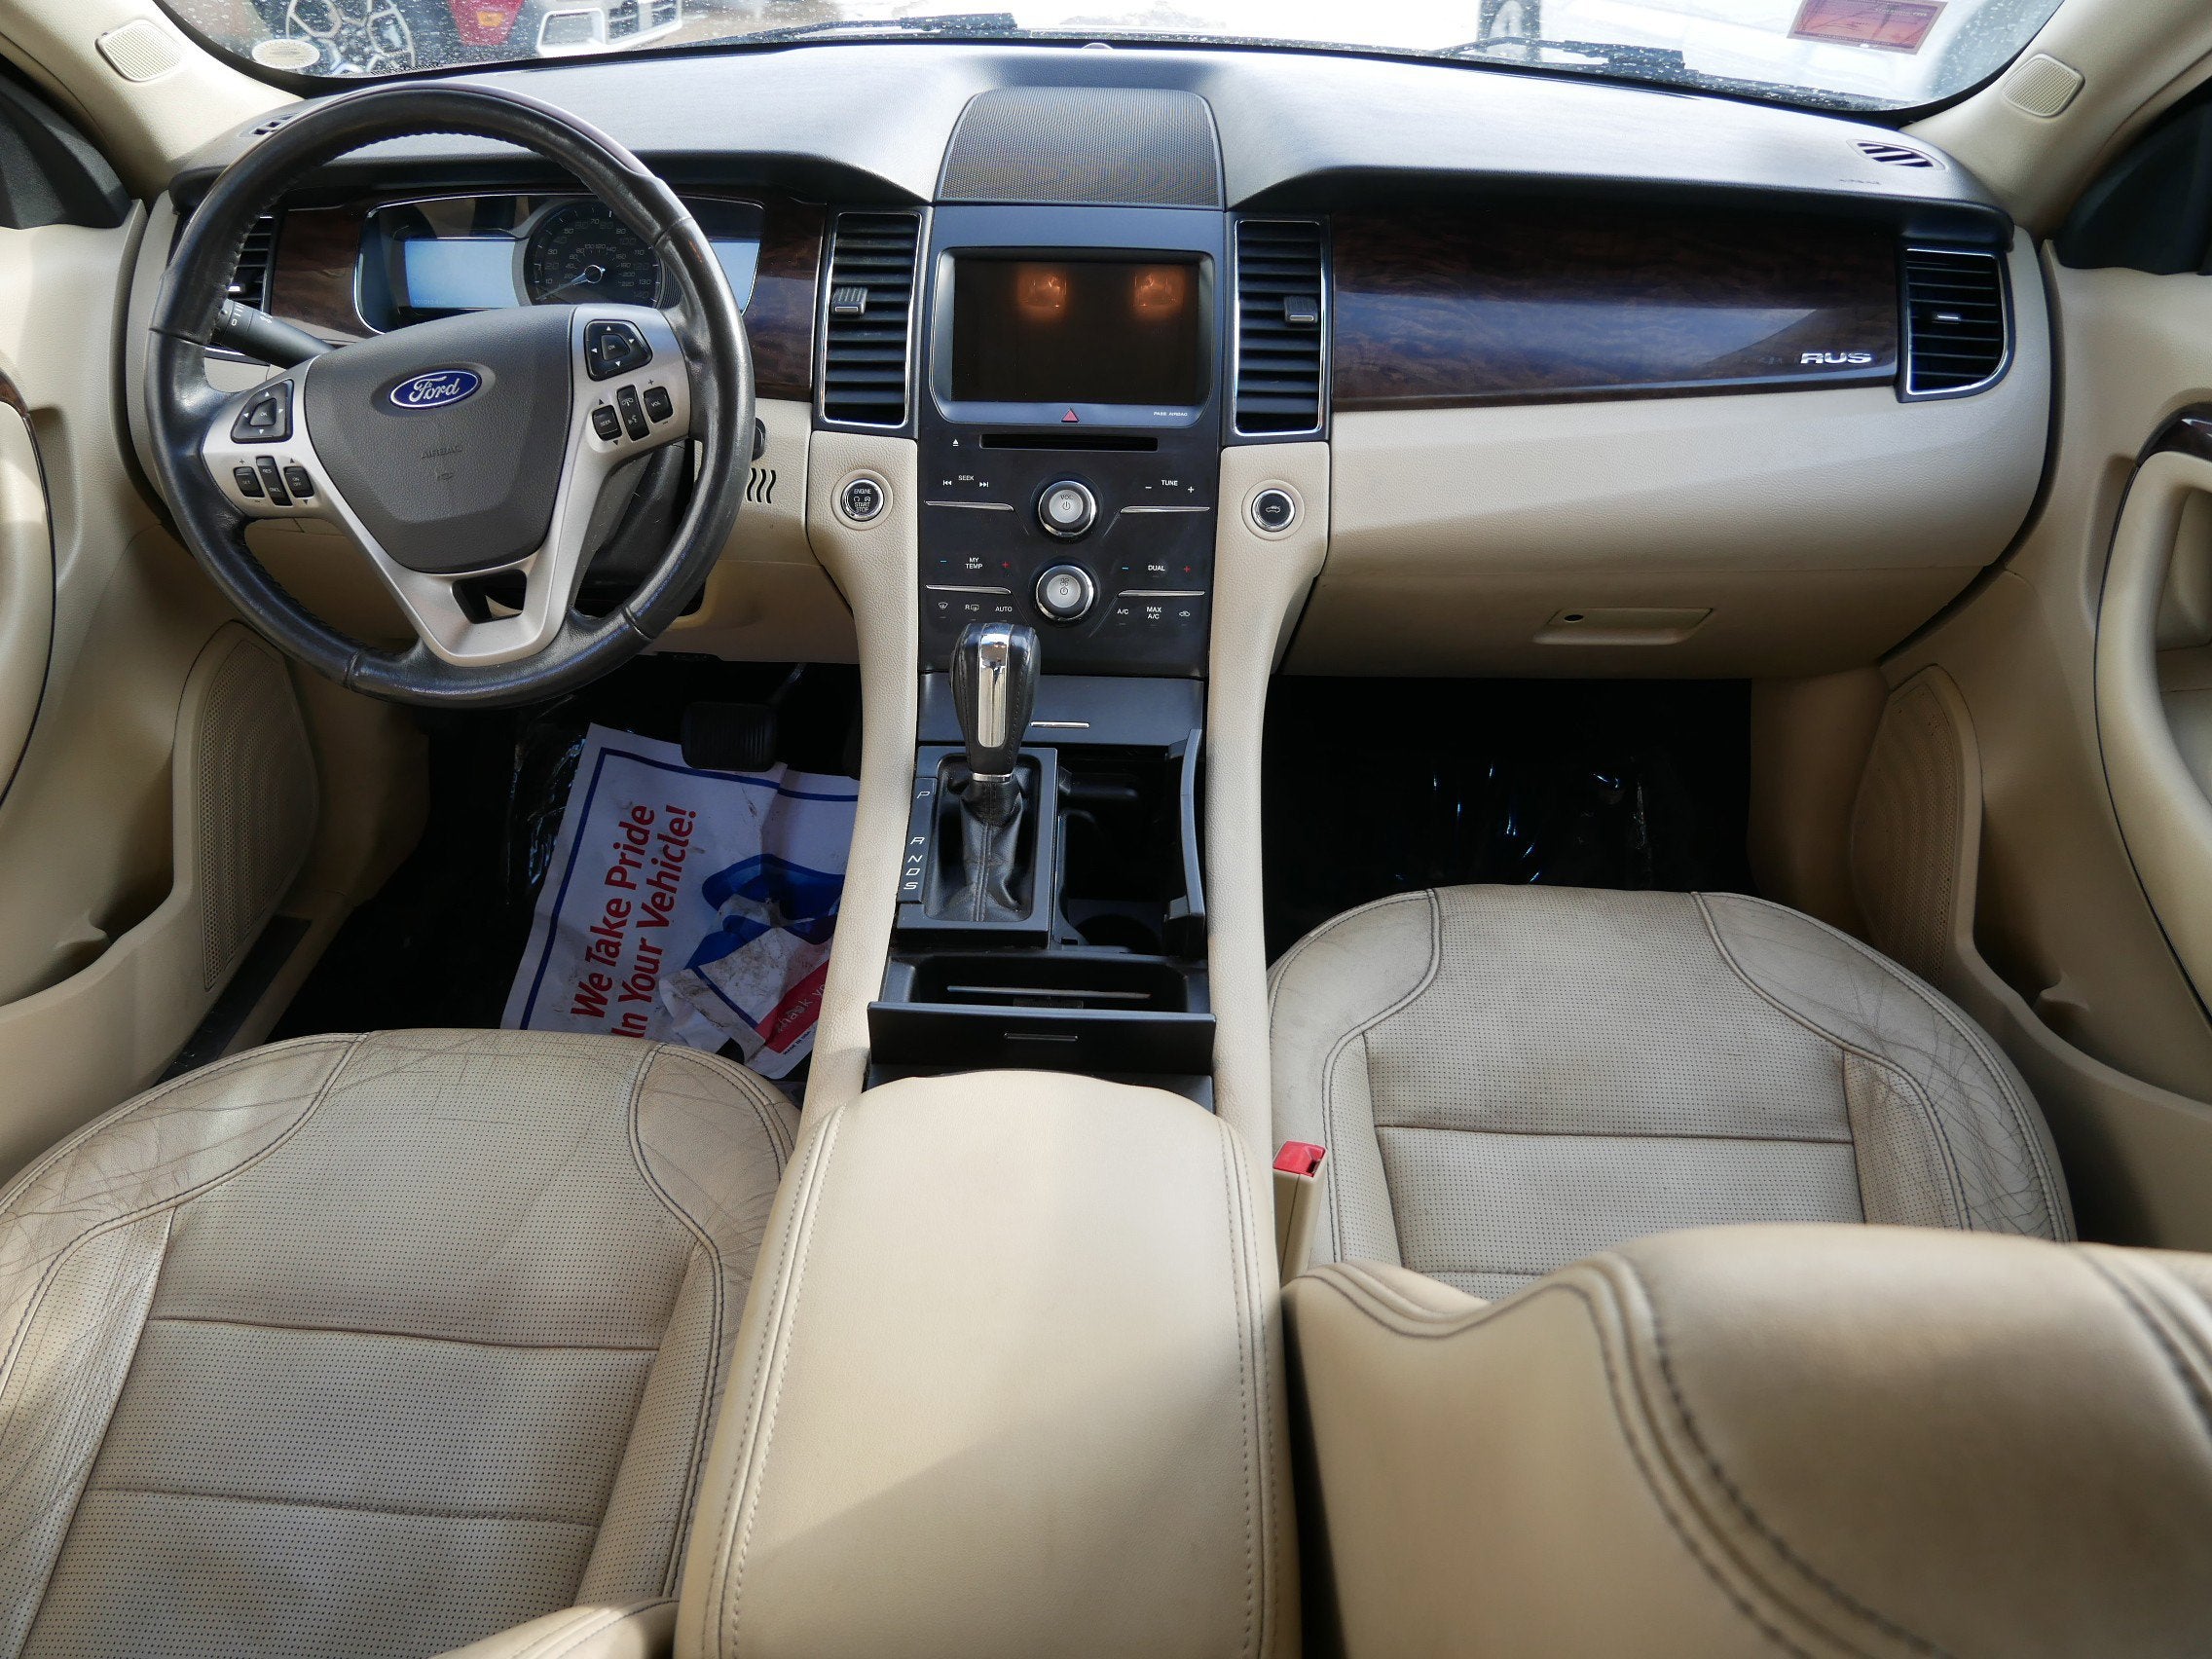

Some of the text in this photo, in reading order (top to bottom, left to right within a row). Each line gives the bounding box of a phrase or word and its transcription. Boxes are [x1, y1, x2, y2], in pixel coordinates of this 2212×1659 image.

[1800, 352, 1871, 364] RUS
[409, 376, 460, 402] Ford
[916, 791, 931, 799] P
[909, 836, 925, 845] R
[905, 867, 921, 876] D
[903, 881, 919, 890] S
[571, 805, 655, 1018] We Take Pride
[610, 805, 697, 1039] In Your Vehicle!
